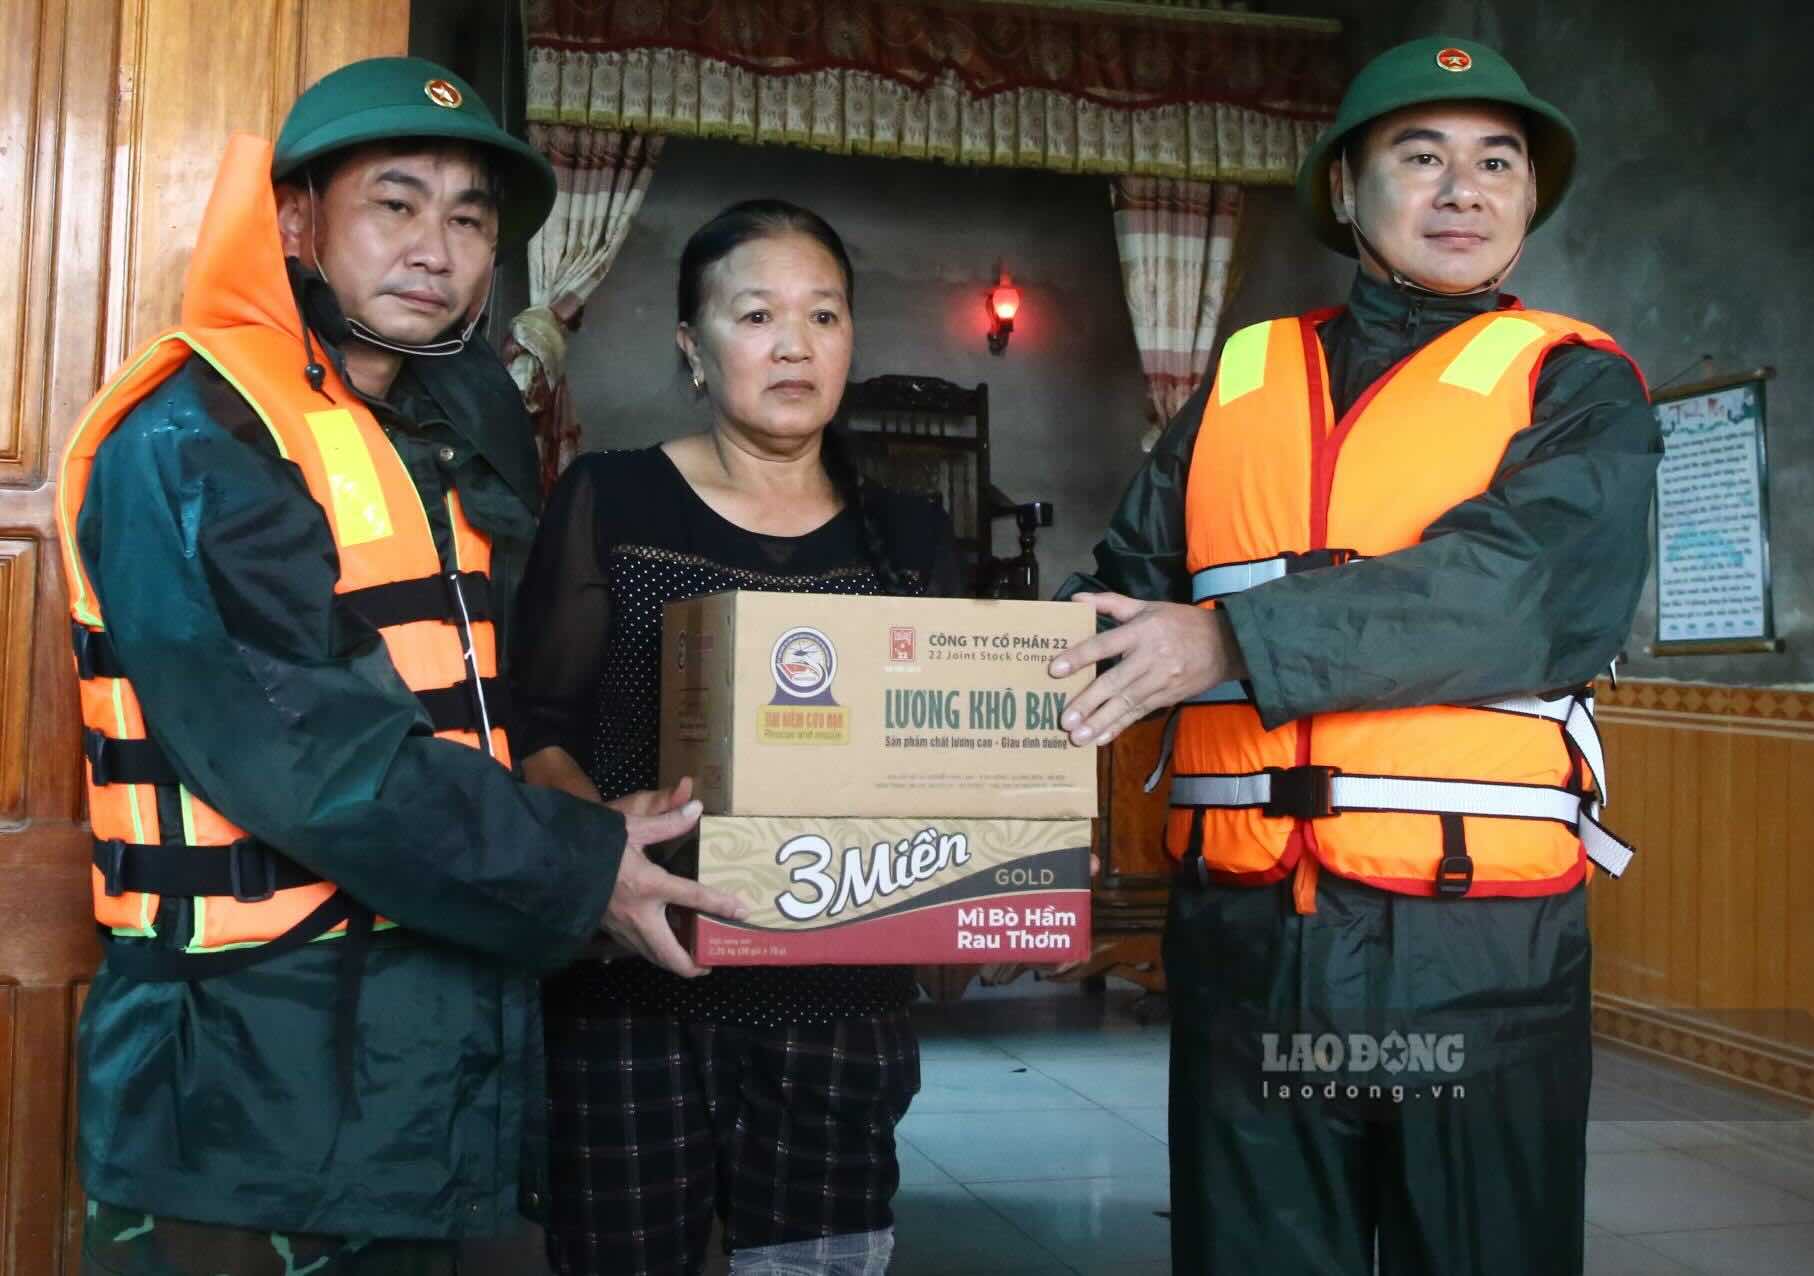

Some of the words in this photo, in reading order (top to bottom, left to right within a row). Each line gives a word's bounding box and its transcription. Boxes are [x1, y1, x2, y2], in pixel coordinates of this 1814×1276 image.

[929, 633, 967, 647] CÔNG
[972, 635, 989, 647] TY
[1053, 638, 1068, 649] 22
[929, 650, 942, 660] 22
[946, 650, 976, 661] Joint
[980, 651, 1011, 661] Stock
[885, 688, 960, 729] LƯƠNG
[968, 687, 1017, 730] KHÔ
[1025, 691, 1067, 730] BAY
[977, 738, 993, 748] cao
[775, 834, 836, 922] 3
[826, 827, 971, 916] Miền
[995, 868, 1054, 885] GOLD
[957, 907, 985, 927] Mì
[989, 906, 1019, 927] Bò
[1025, 905, 1077, 927] Hầm
[957, 930, 1001, 949] Rau
[1006, 929, 1071, 949] Thơm
